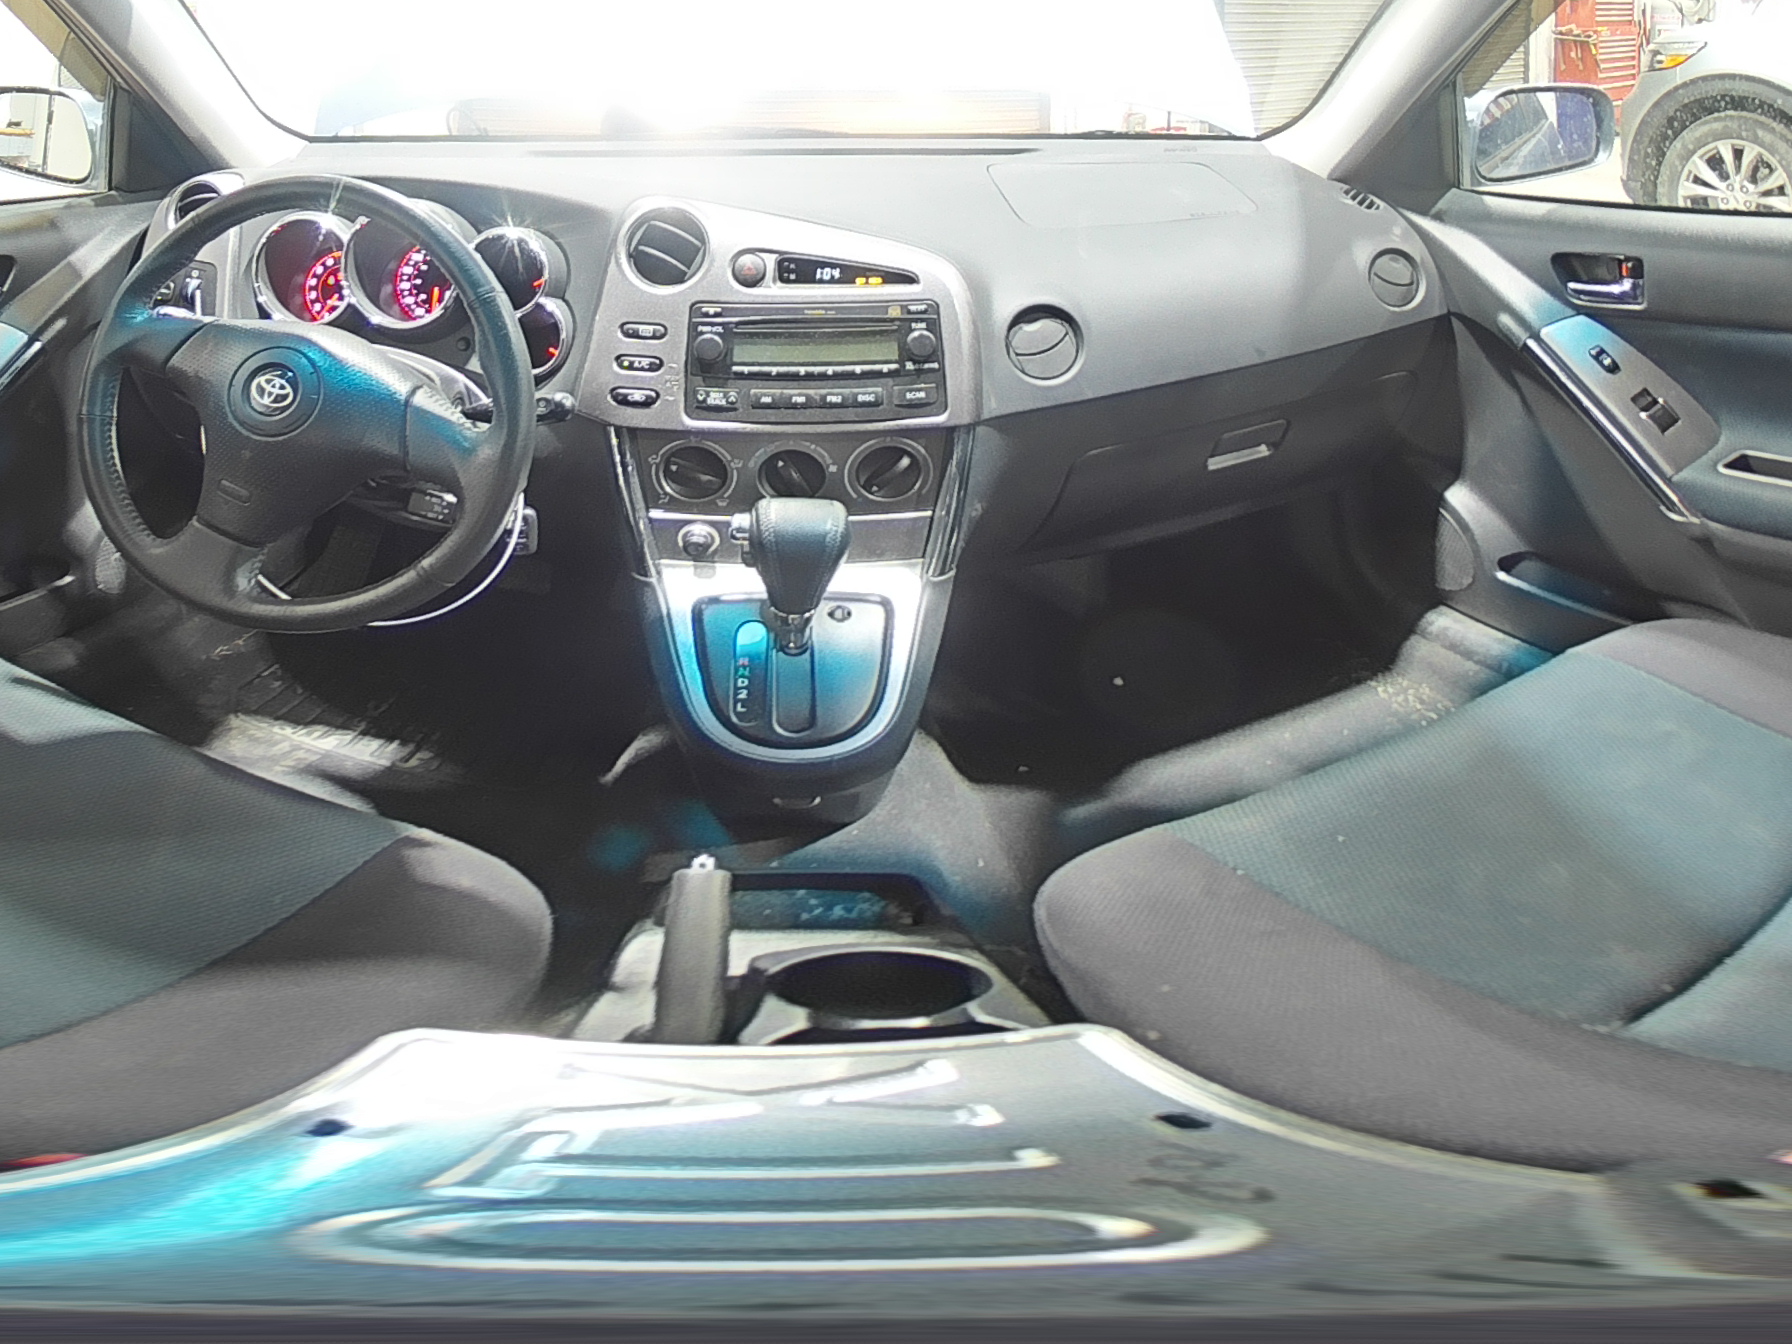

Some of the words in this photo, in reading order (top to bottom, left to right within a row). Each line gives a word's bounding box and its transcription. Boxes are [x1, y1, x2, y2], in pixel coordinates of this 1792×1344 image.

[633, 360, 650, 369] A/C
[737, 678, 749, 687] D
[736, 701, 748, 712] L
